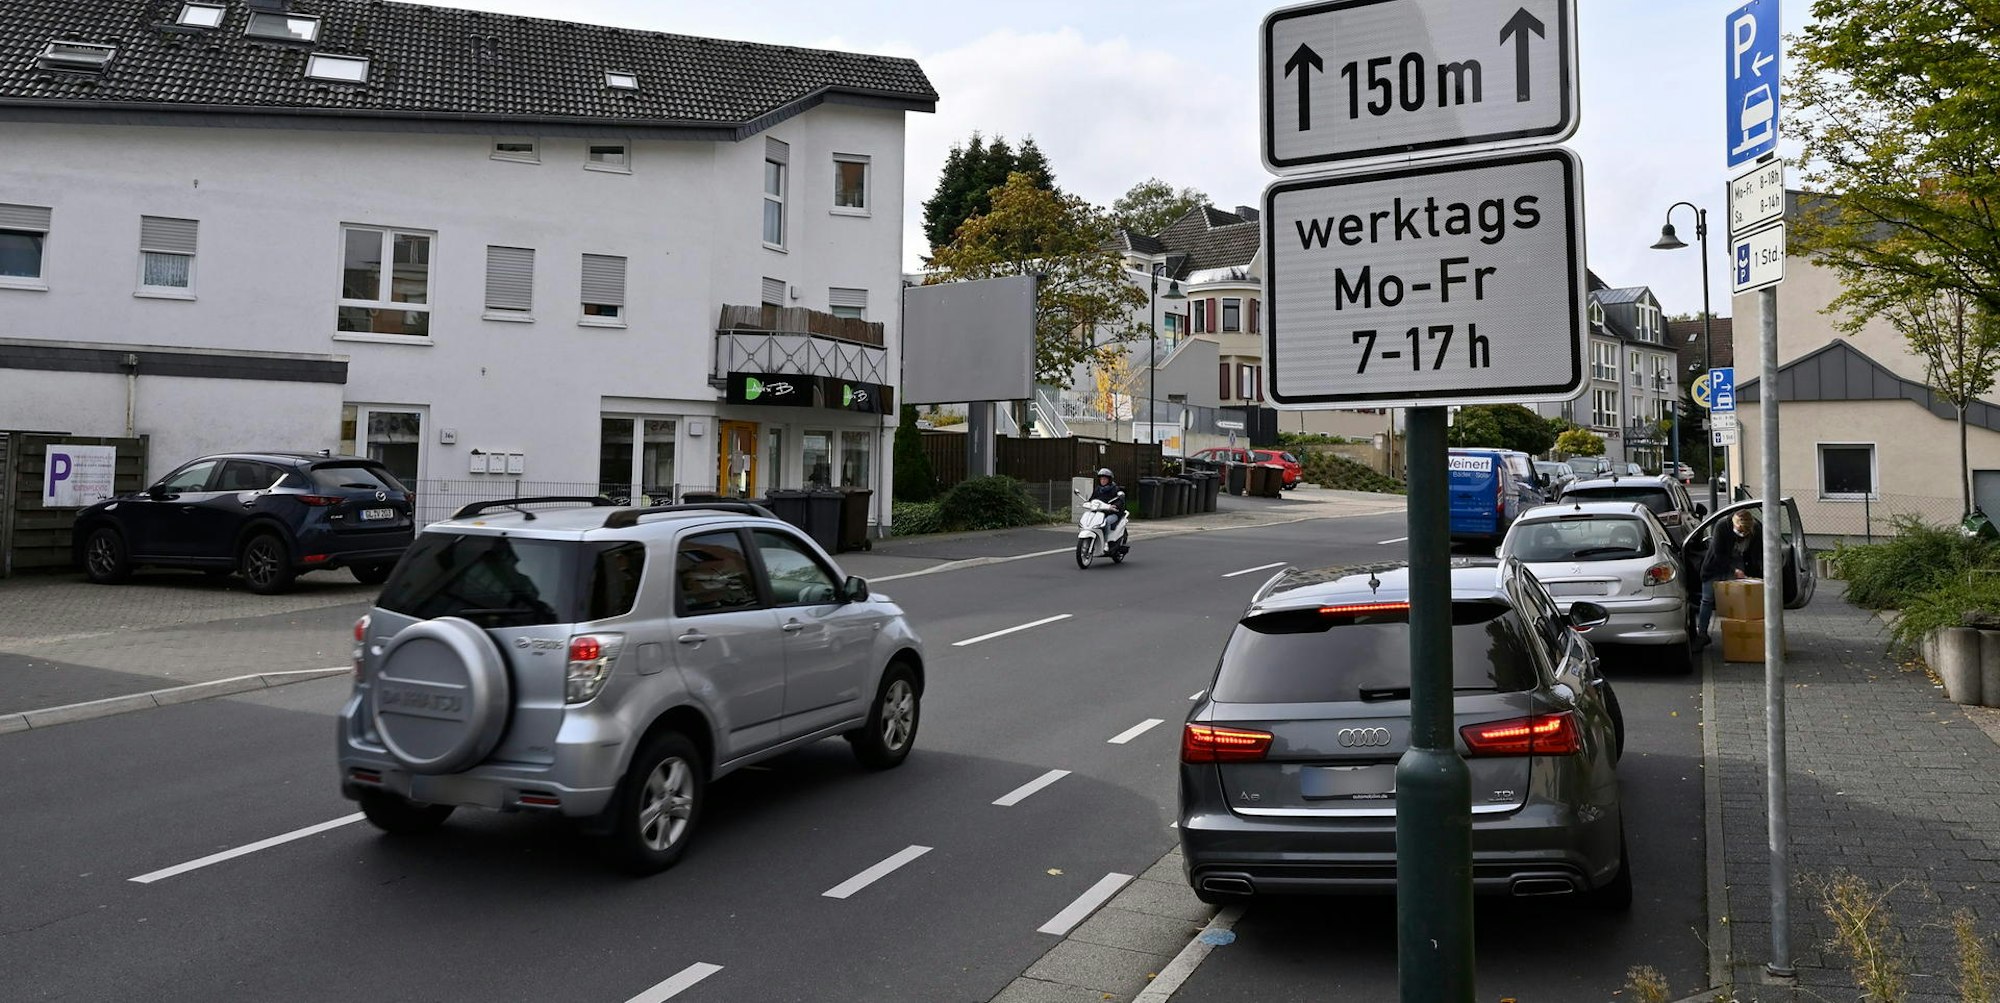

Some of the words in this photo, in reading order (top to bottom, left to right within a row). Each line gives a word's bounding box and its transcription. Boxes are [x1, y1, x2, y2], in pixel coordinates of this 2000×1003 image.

[1733, 13, 1757, 80] P
[1295, 194, 1541, 250] werktags
[1334, 256, 1497, 310] Mo-Fr
[1352, 324, 1454, 374] 7-17
[49, 453, 72, 497] P
